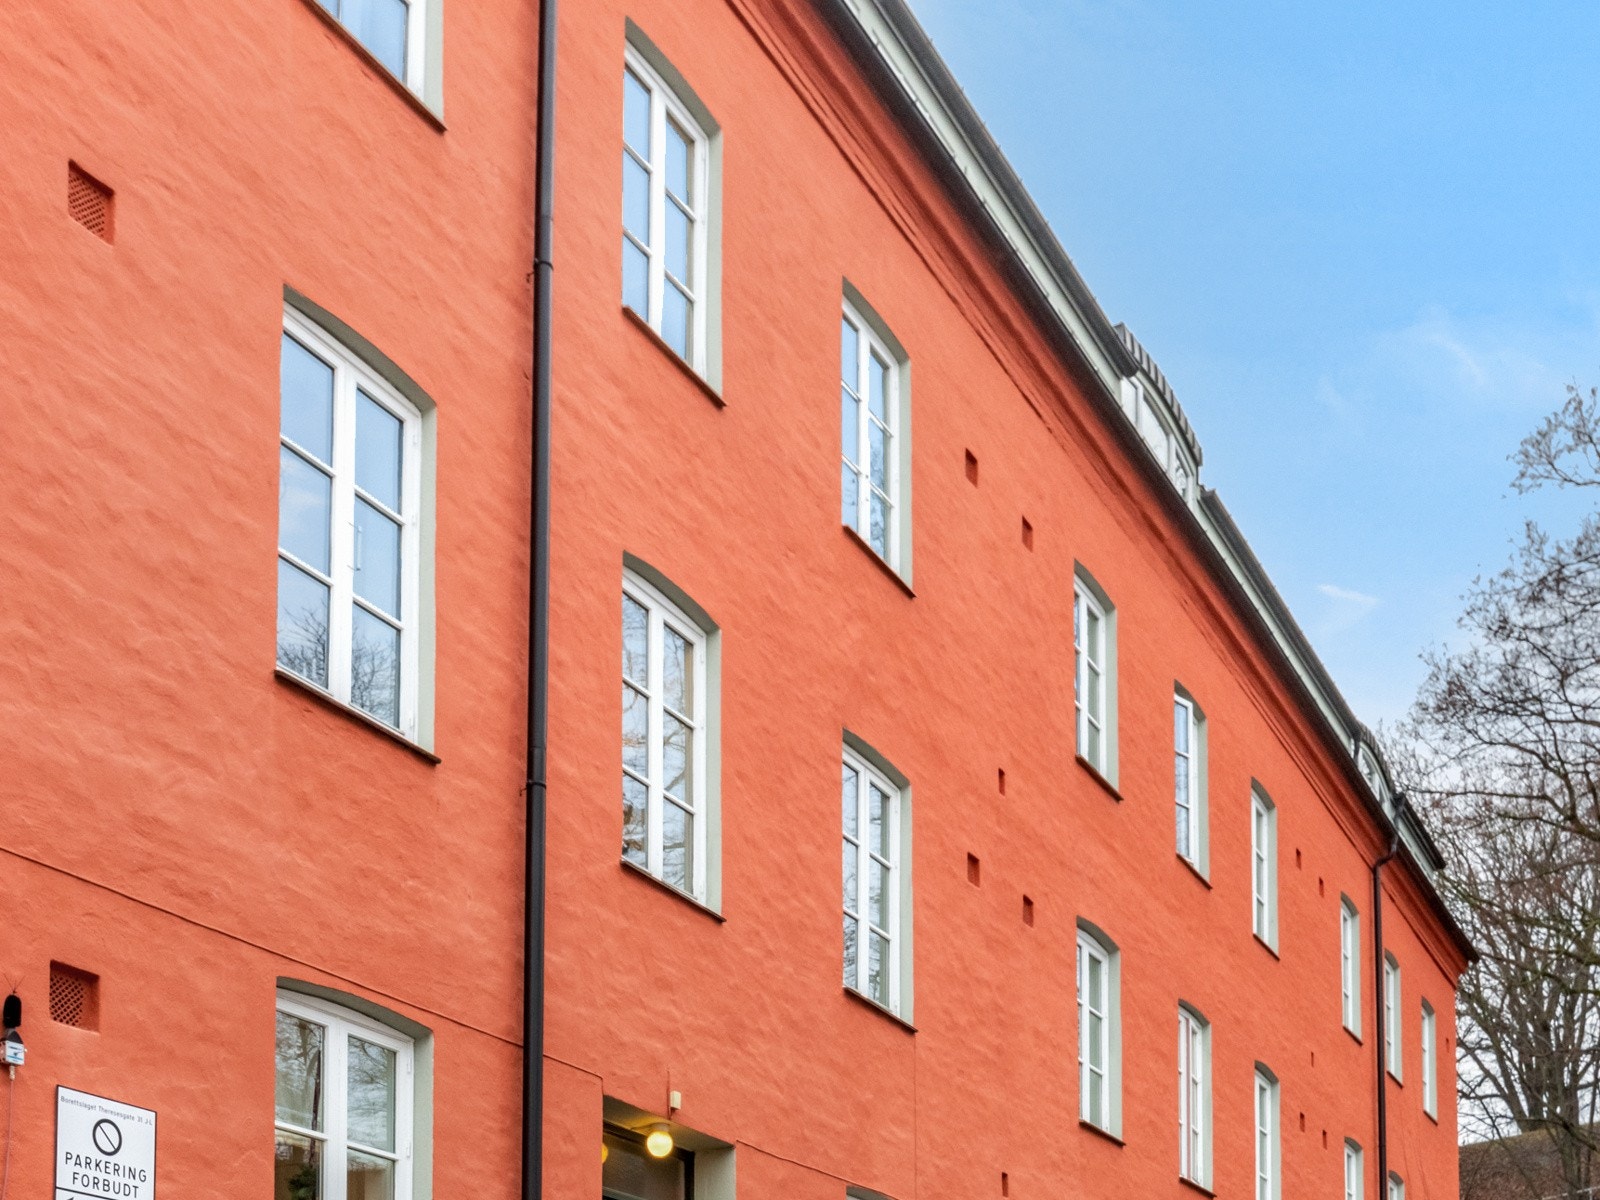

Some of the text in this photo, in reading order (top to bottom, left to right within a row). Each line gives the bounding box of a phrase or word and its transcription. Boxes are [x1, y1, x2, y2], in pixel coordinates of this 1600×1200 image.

[60, 1095, 97, 1111] Borettslaget
[98, 1105, 135, 1120] Theresesgate
[65, 1151, 147, 1183] PARKERING
[72, 1171, 139, 1199] FORBUDT
